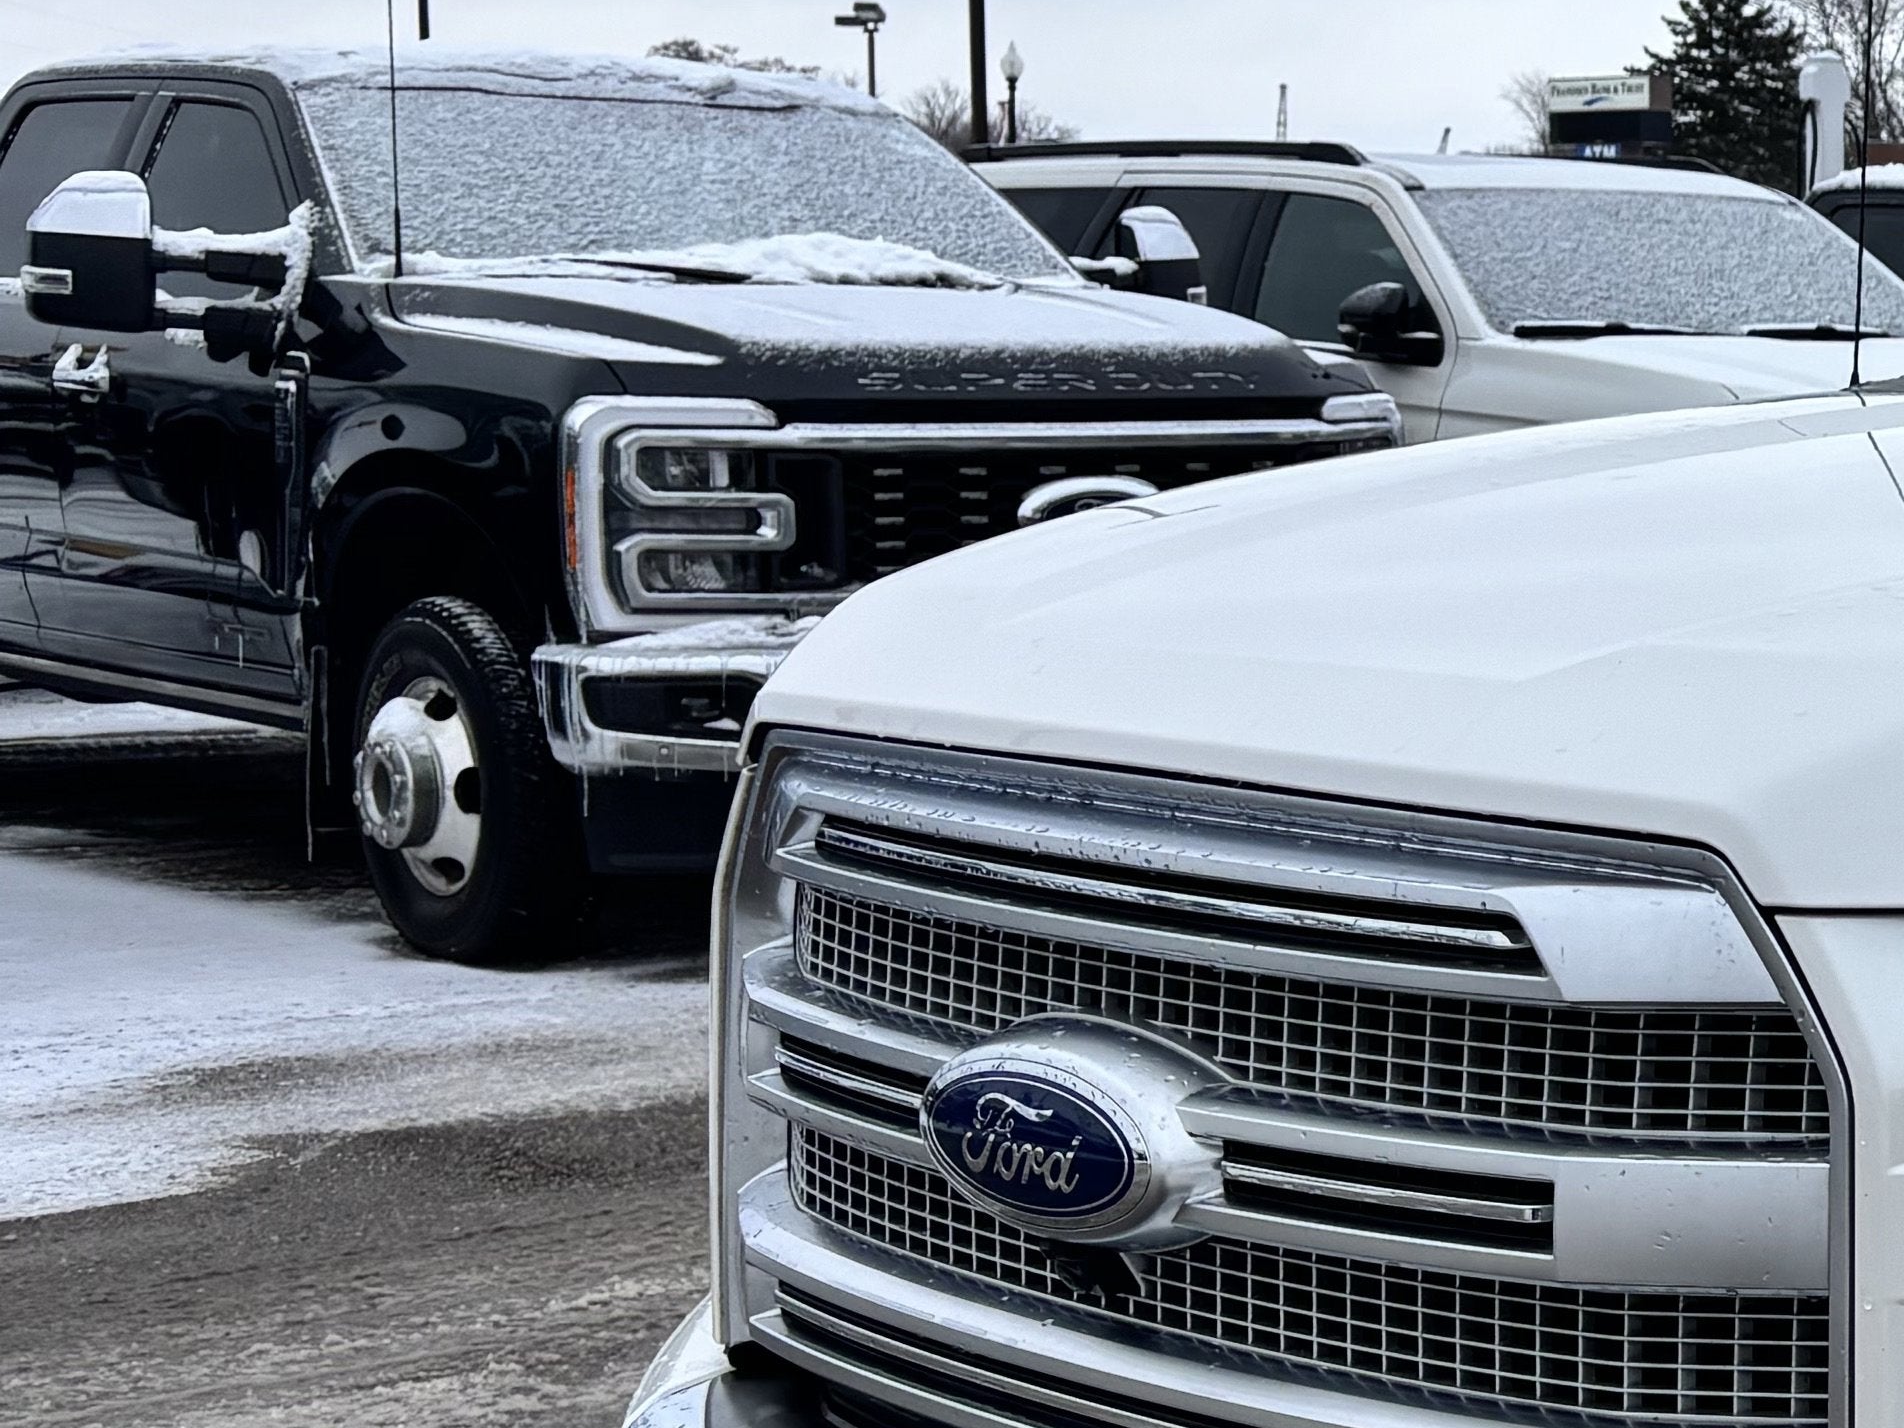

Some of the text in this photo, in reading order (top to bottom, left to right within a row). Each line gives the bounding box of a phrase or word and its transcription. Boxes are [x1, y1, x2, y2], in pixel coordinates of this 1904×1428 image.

[1583, 144, 1617, 159] ATM
[857, 371, 1260, 391] SUPER DUTY
[961, 1092, 1083, 1194] Ford
